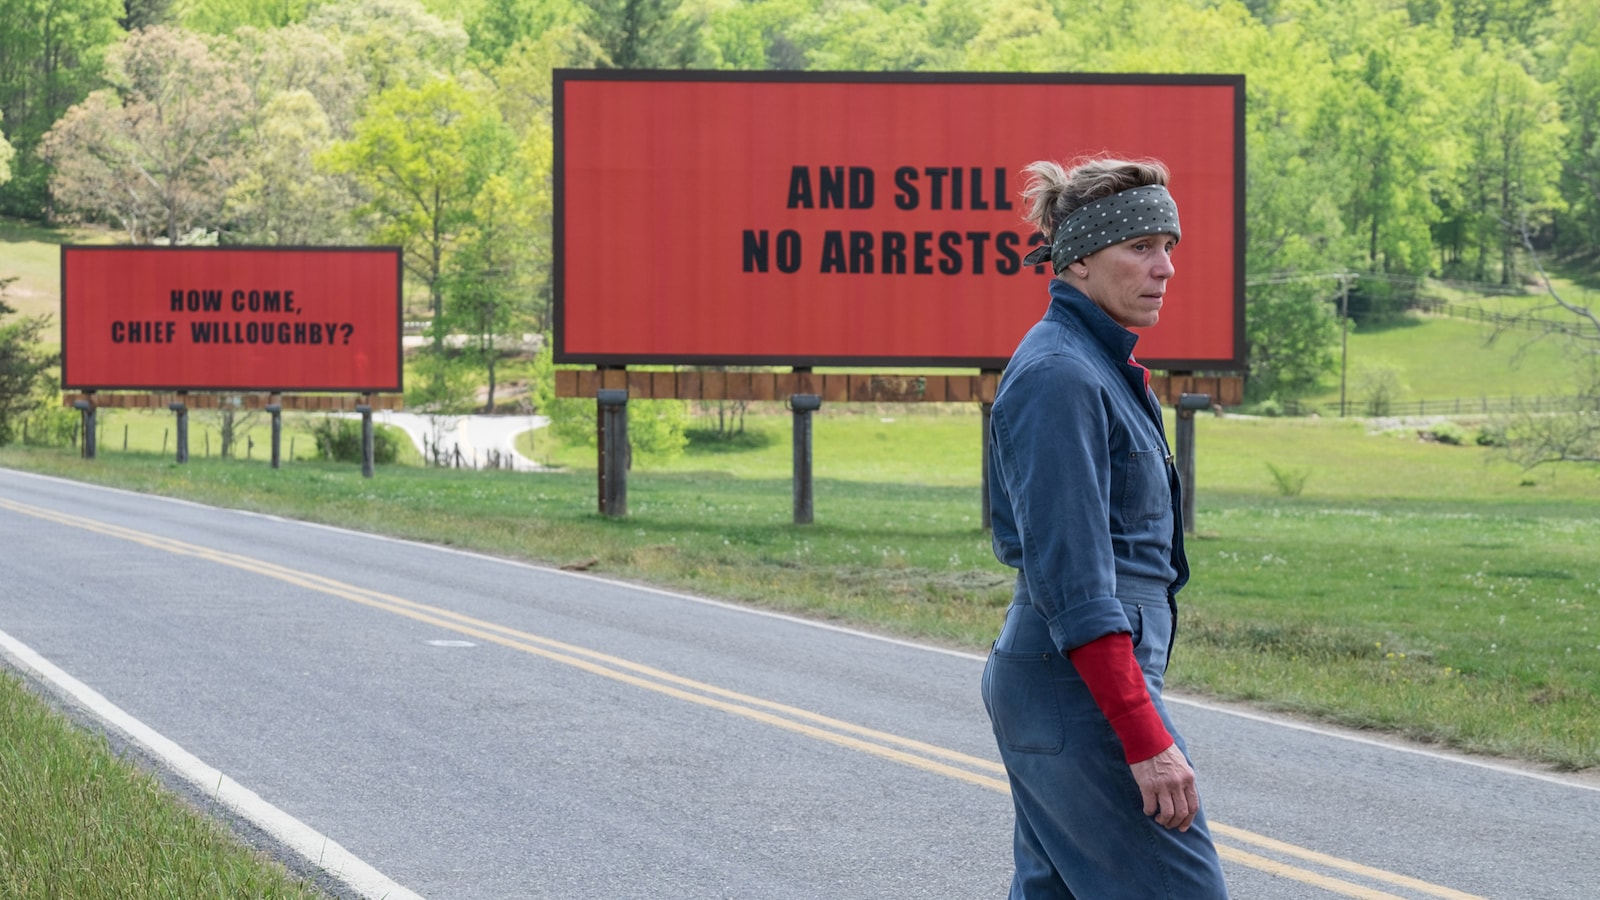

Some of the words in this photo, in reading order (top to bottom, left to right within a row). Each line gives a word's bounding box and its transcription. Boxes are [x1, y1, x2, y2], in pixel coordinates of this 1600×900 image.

[787, 166, 875, 210] AND
[894, 166, 1013, 211] STILL
[742, 229, 802, 274] NO
[170, 289, 223, 313] HOW
[231, 289, 302, 315] COME,
[111, 321, 176, 344] CHIEF
[191, 321, 355, 345] WILLOUGHBY?
